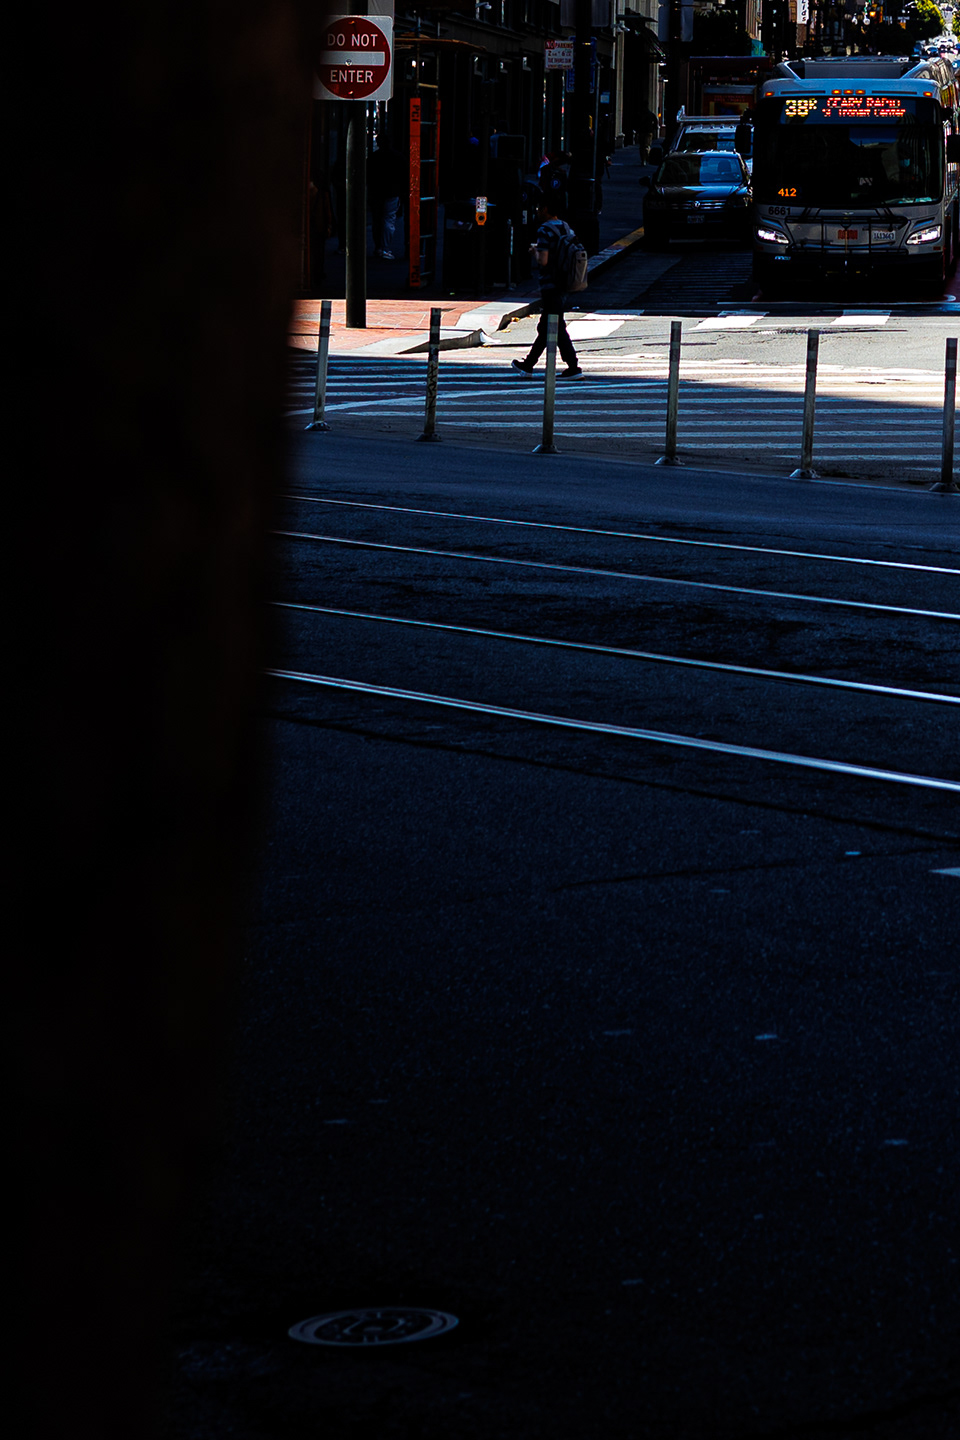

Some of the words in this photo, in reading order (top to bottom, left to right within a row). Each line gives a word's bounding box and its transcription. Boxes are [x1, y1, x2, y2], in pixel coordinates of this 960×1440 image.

[327, 33, 345, 47] DO
[351, 33, 378, 47] NOT
[330, 70, 374, 83] ENTER
[778, 187, 797, 197] 412
[768, 206, 791, 216] 6661
